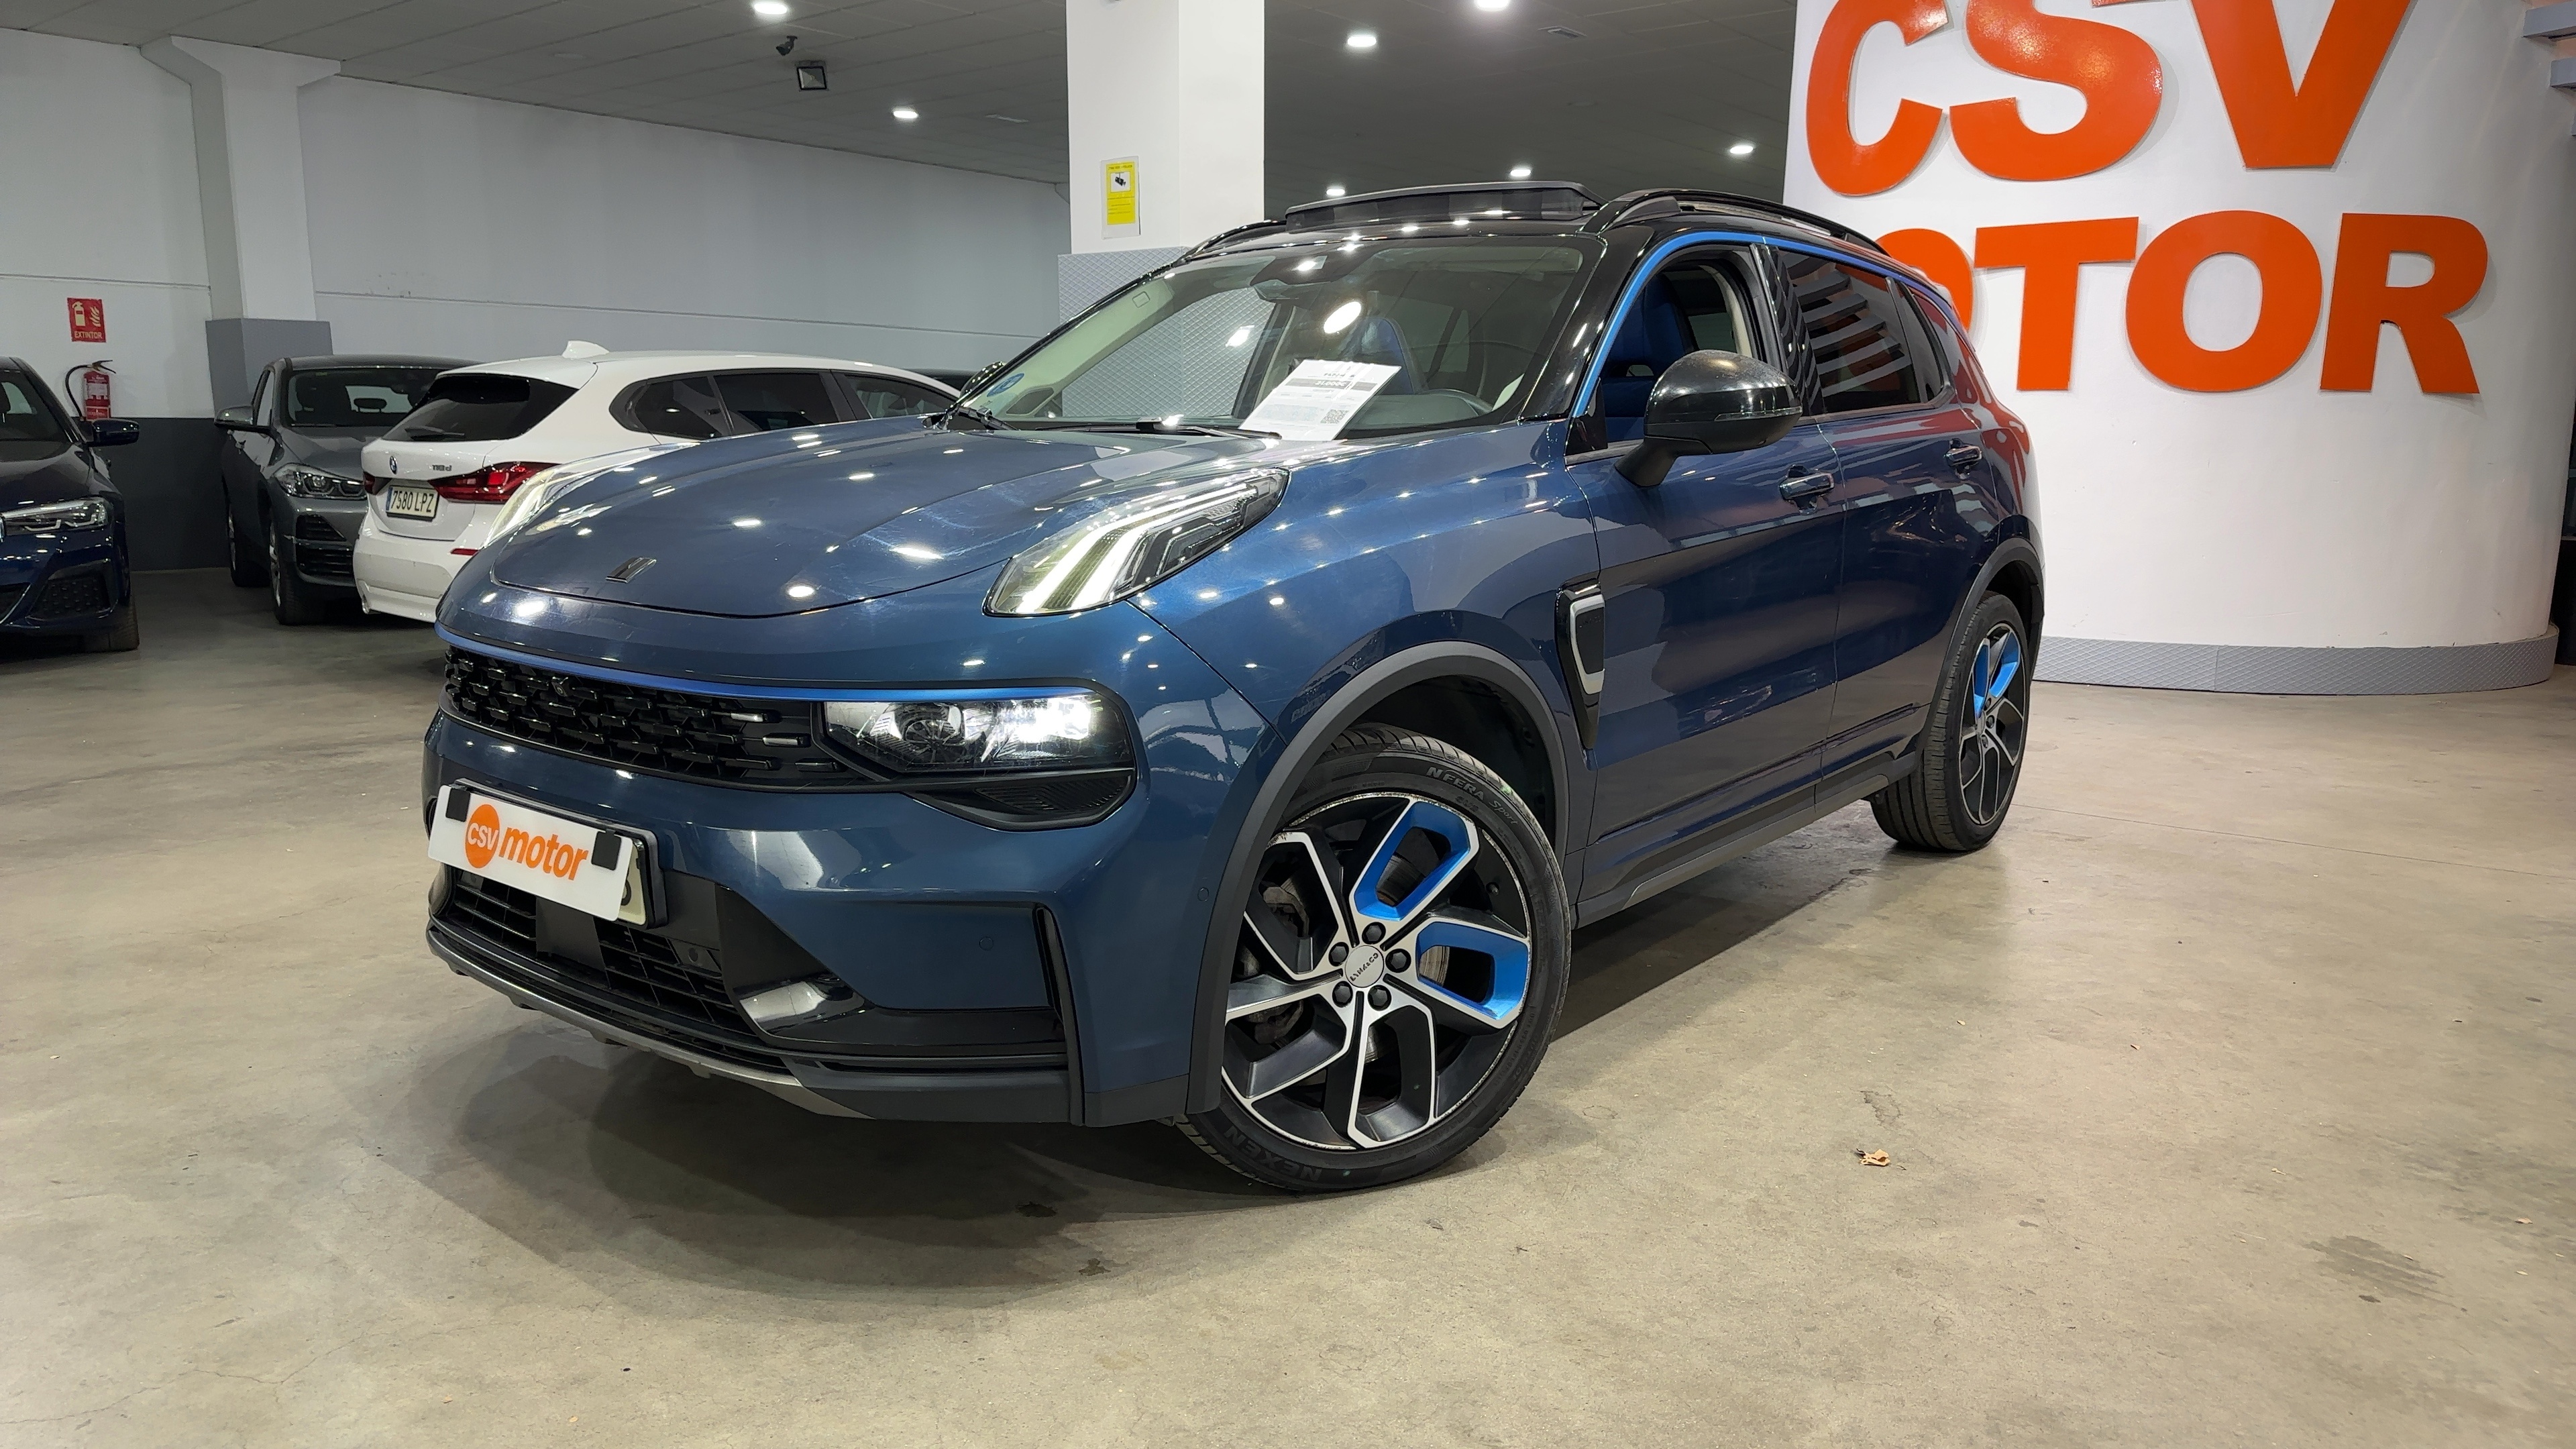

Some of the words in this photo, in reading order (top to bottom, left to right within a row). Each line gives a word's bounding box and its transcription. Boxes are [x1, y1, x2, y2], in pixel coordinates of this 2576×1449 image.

[1807, 0, 2414, 195] CSV
[74, 331, 103, 339] EXTINTOR
[390, 490, 413, 510] 7580
[414, 492, 434, 513] LPZ
[1489, 800, 1518, 825] Sport
[468, 822, 498, 850] CSV
[498, 827, 588, 880] motor
[1224, 1126, 1322, 1182] NEXEN
